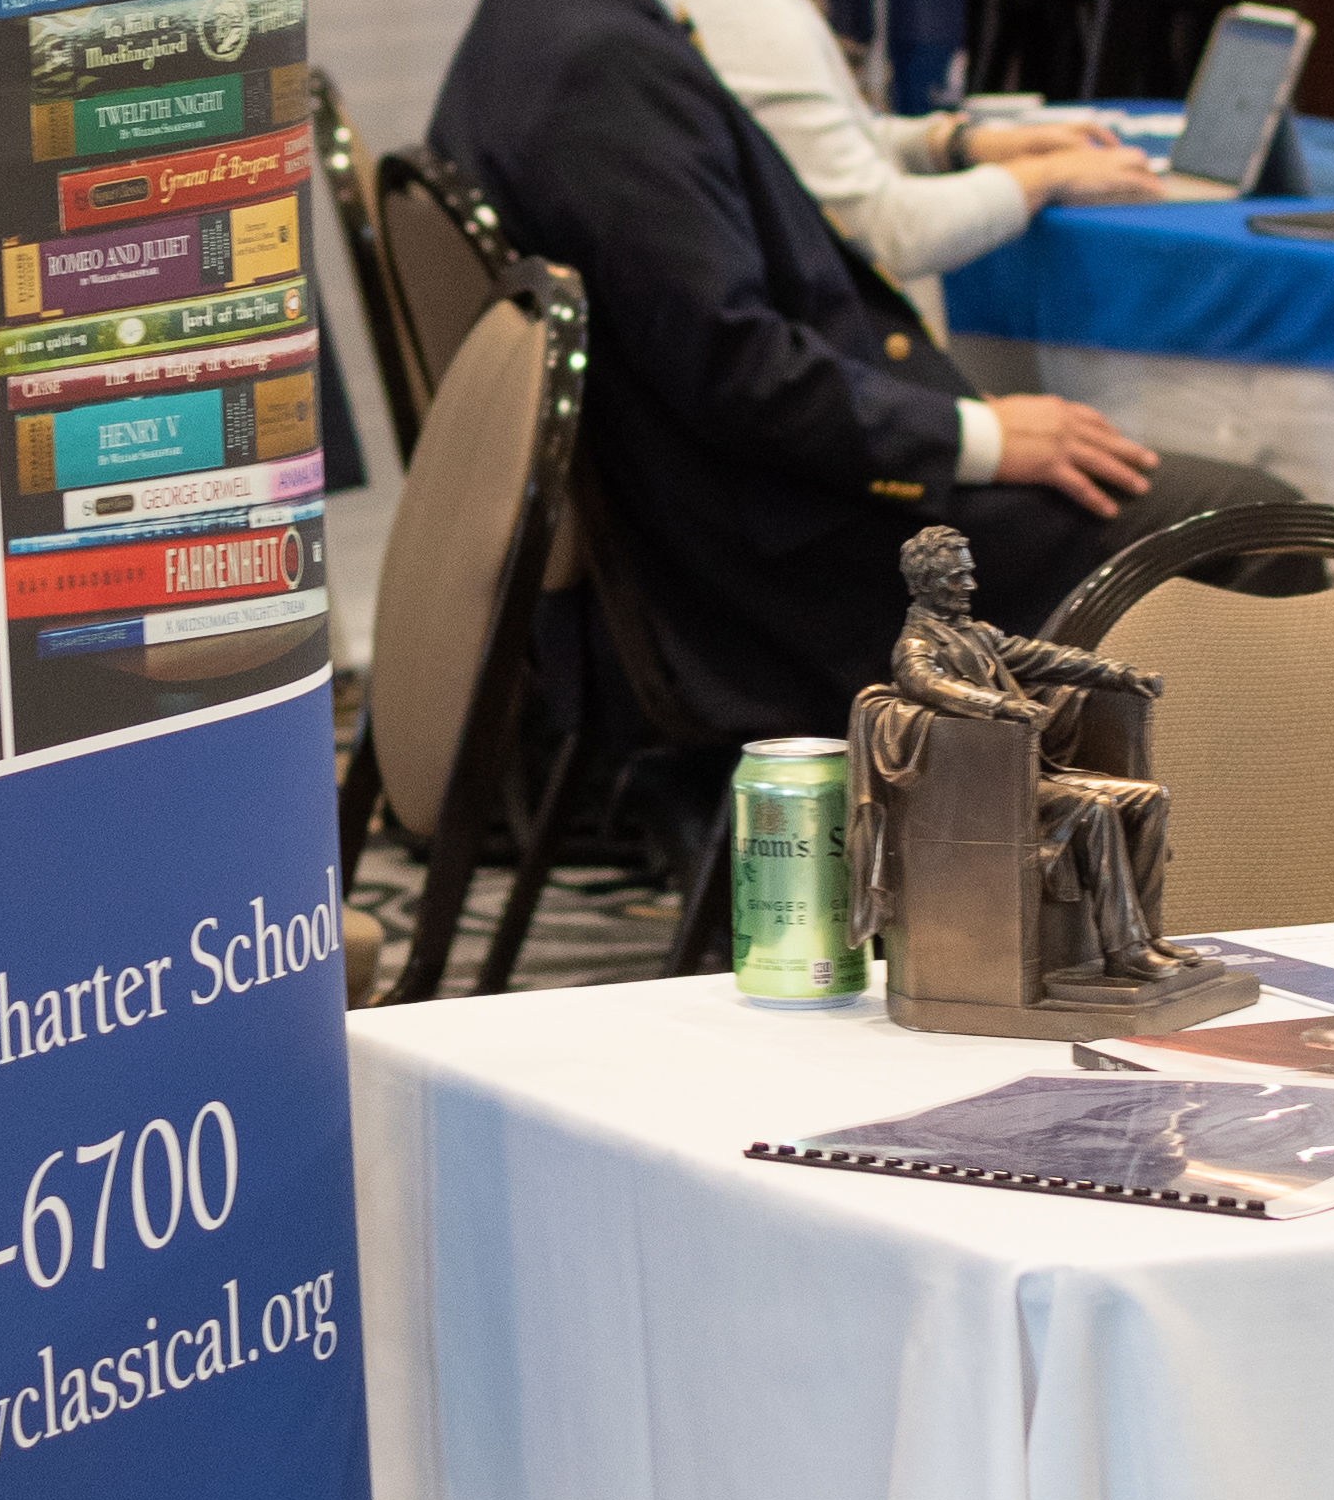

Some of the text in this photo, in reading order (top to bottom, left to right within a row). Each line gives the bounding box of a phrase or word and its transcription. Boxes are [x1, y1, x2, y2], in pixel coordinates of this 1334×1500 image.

[84, 33, 189, 71] Mockingbird
[94, 97, 172, 128] TWELFTH
[173, 89, 226, 117] NIGHT
[159, 168, 210, 204] Cyrano
[46, 247, 104, 277] ROMEO
[104, 242, 141, 269] AND
[141, 234, 192, 268] JULIET
[98, 414, 181, 450] HENRY V
[139, 481, 199, 511] GEORGE
[200, 475, 253, 506] ORWELL
[164, 536, 281, 594] FAHRENHEIT
[189, 863, 341, 1006] School
[774, 914, 808, 926] ALE
